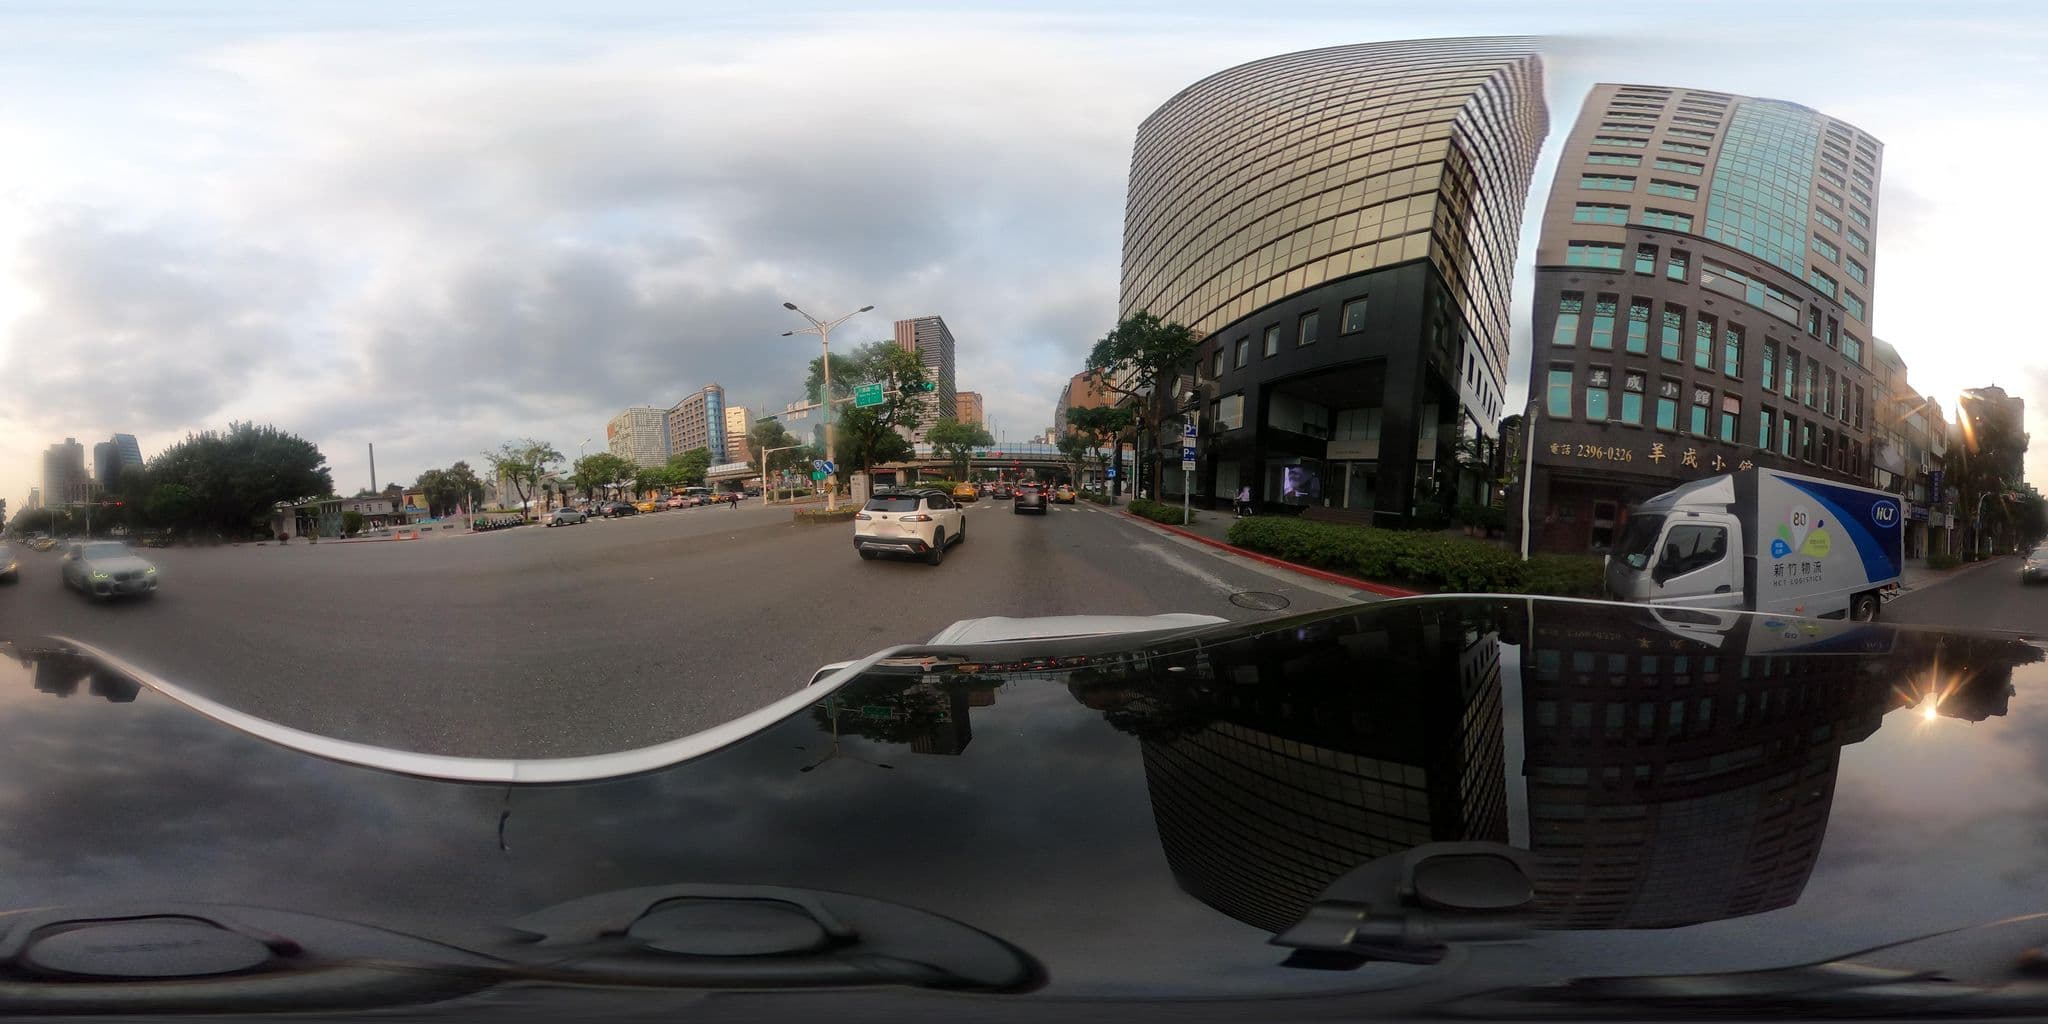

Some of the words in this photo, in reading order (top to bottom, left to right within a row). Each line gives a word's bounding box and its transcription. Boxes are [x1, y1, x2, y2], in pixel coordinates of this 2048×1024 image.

[1591, 370, 1711, 404] 羊成小館
[1550, 443, 1571, 455] 電話
[1577, 444, 1632, 463] 2396-0326
[1793, 512, 1806, 526] 80
[1876, 507, 1894, 521] HCT
[1773, 561, 1822, 577] 新竹物流
